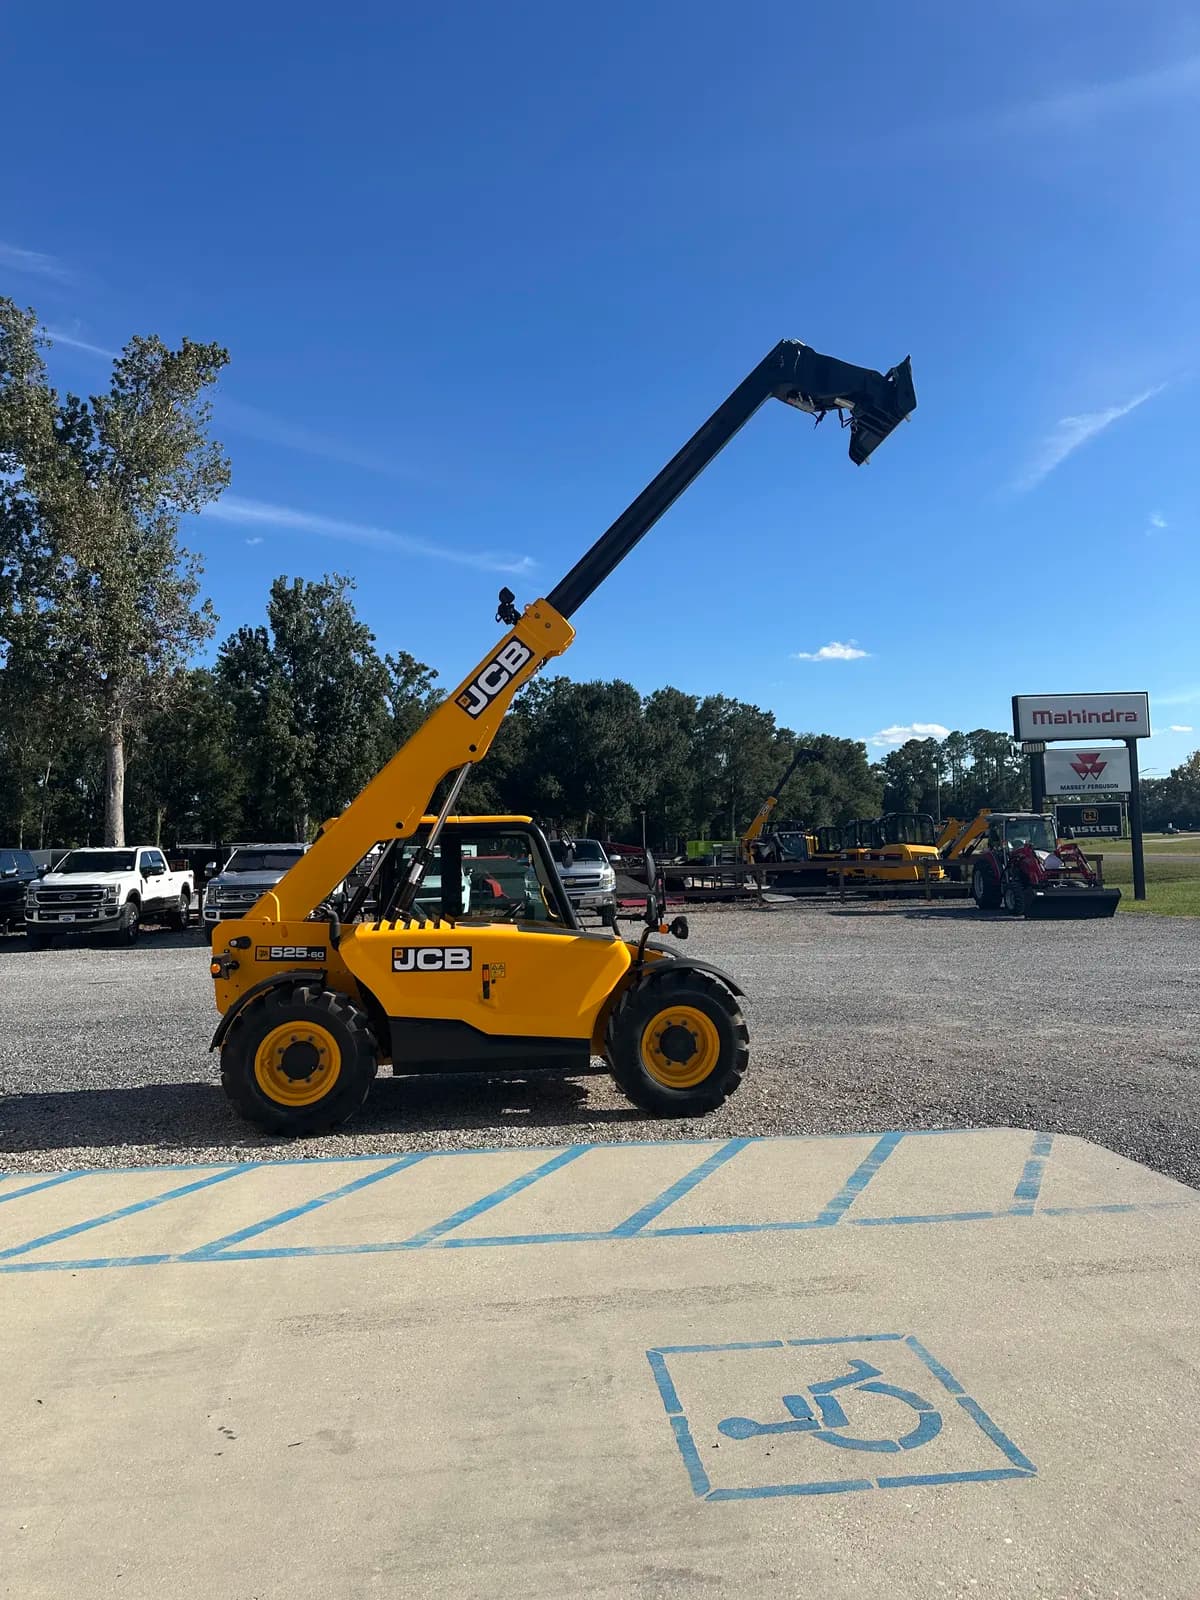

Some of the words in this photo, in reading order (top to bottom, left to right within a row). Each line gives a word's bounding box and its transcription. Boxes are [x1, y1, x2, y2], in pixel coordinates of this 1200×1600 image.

[467, 640, 530, 715] JCB
[1032, 709, 1138, 725] Mahindra
[394, 948, 471, 970] JCB
